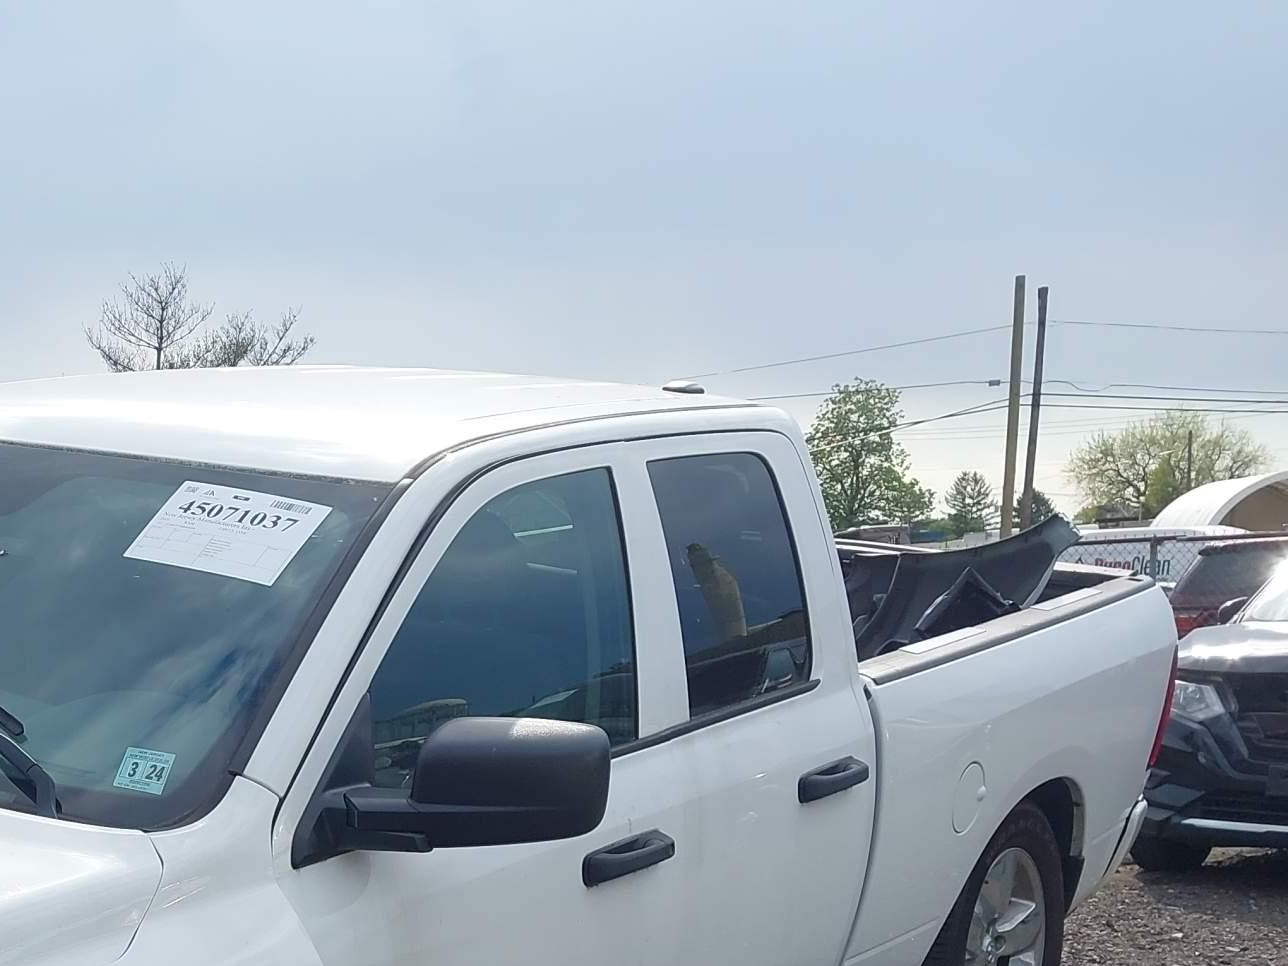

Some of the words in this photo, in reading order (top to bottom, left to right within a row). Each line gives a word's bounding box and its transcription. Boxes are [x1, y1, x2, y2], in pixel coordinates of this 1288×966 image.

[178, 499, 301, 533] 45071037
[127, 761, 139, 778] 3
[145, 765, 166, 782] 24
